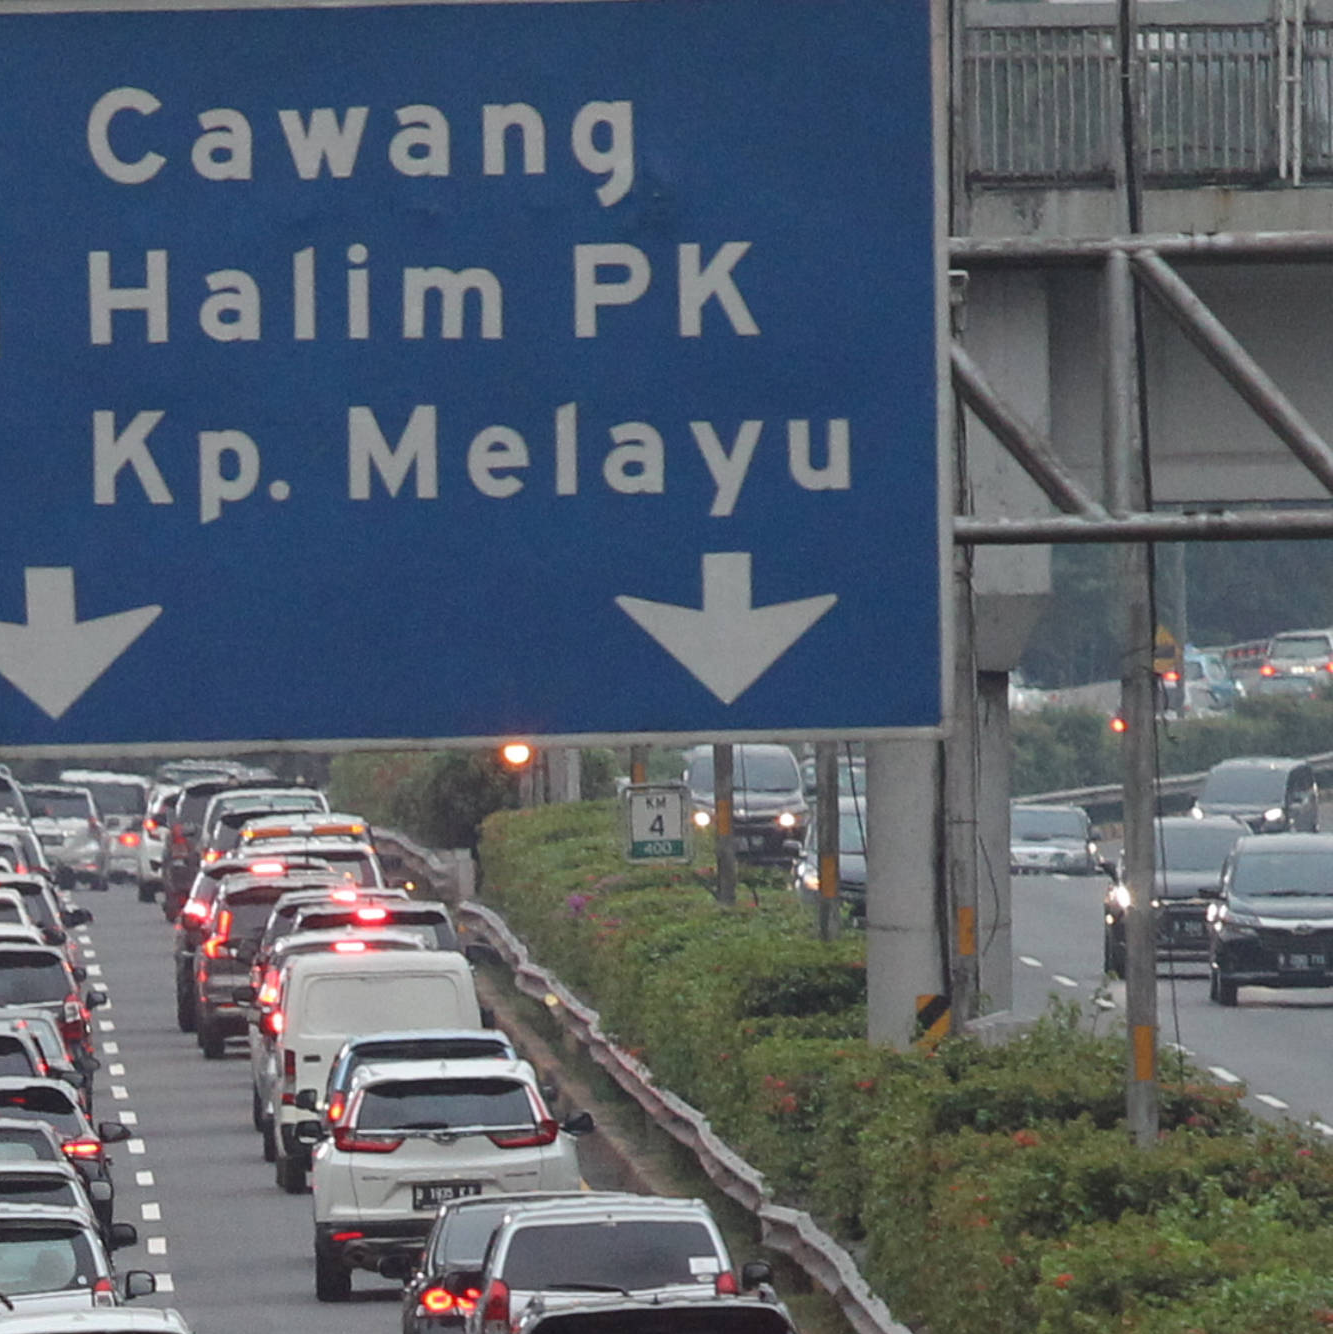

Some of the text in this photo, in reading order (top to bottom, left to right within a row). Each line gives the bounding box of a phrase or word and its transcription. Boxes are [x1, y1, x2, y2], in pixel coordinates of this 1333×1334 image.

[88, 88, 634, 206] Cawang
[89, 242, 761, 344] Halim PK
[93, 403, 850, 524] Kp. Melayu
[645, 796, 667, 810] KM
[649, 814, 664, 837] 4
